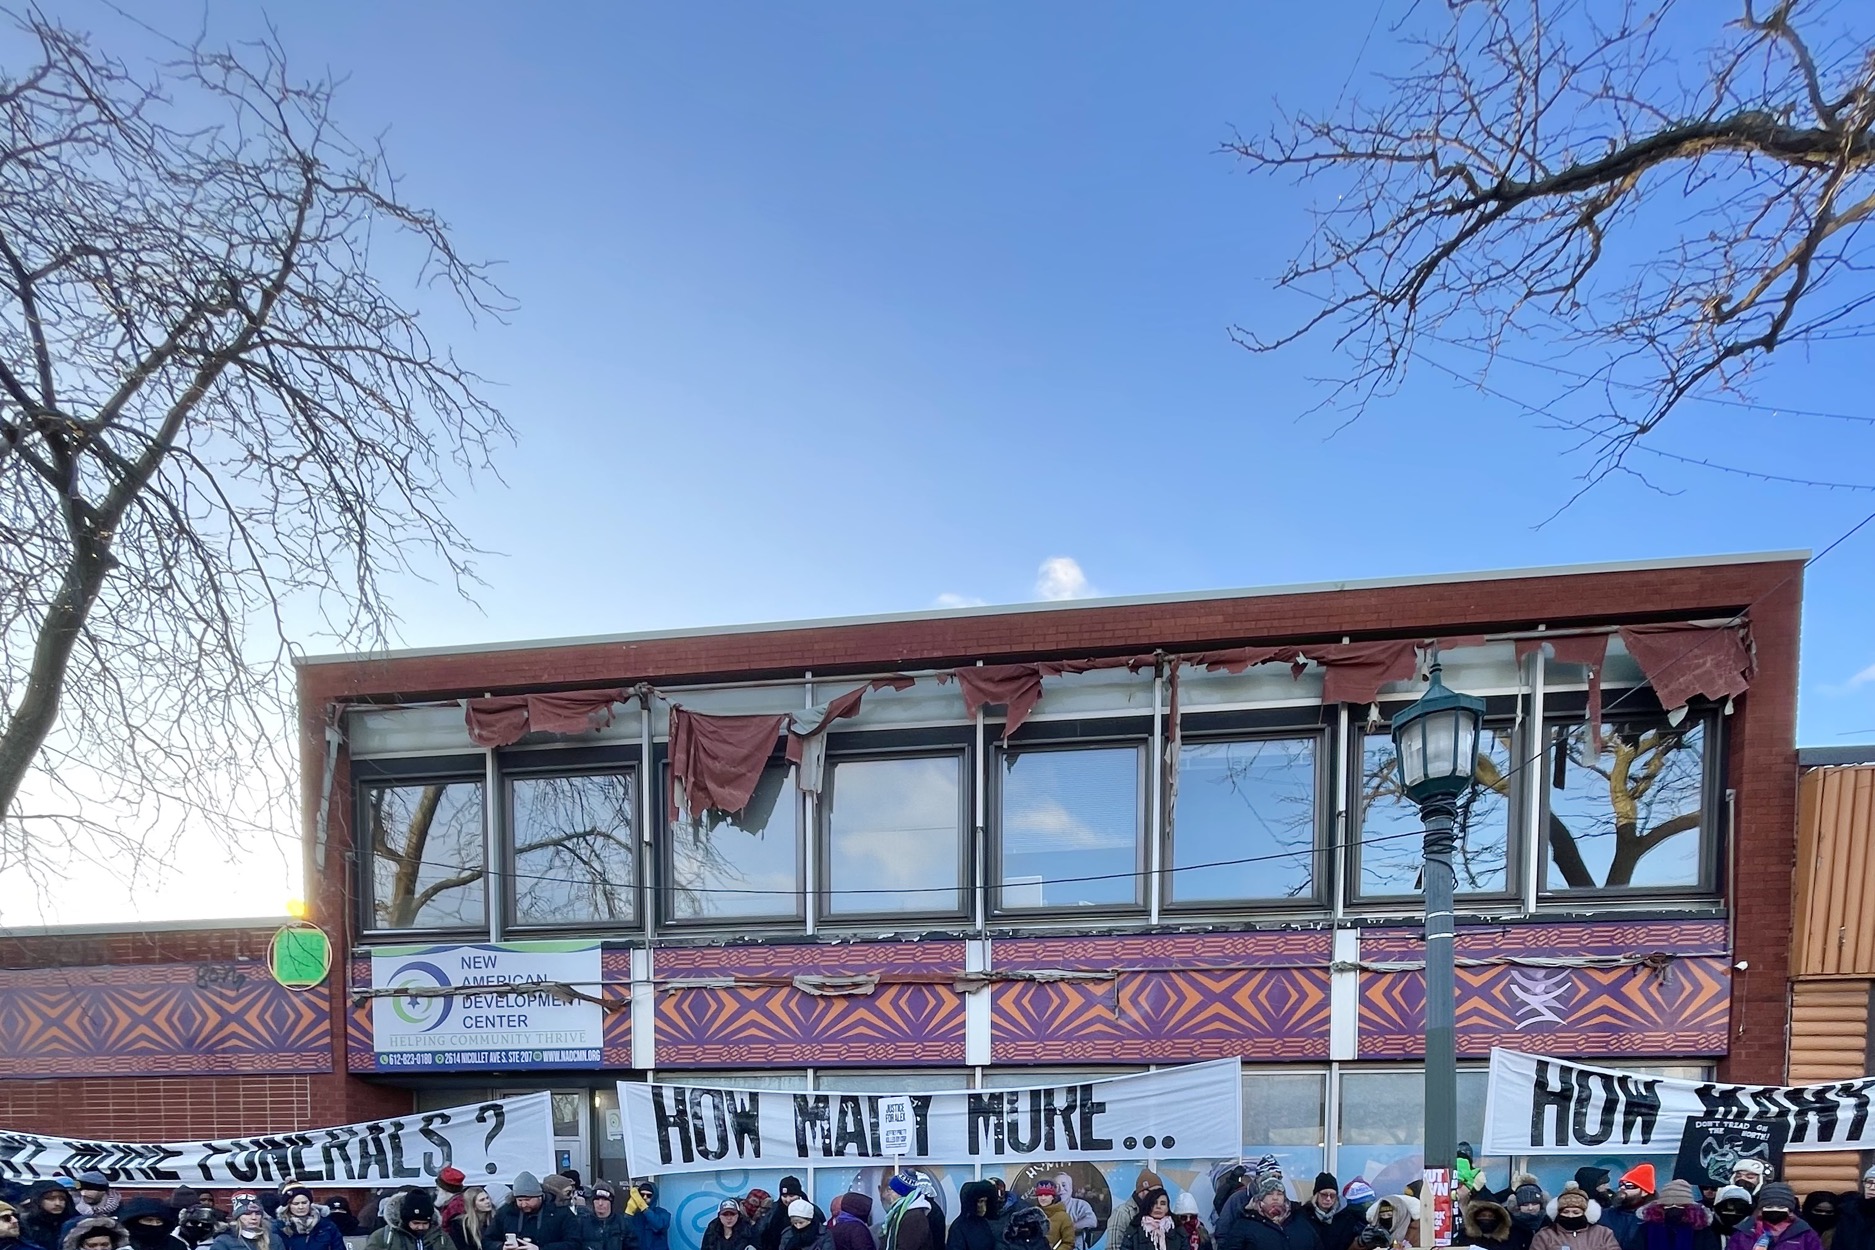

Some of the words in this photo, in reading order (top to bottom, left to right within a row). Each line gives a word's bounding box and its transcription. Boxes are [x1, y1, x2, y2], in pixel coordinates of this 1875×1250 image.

[461, 955, 497, 969] NEW
[463, 974, 548, 988] AMERICAN
[462, 1014, 528, 1029] CENTER
[390, 1035, 446, 1047] HELPING
[450, 1033, 532, 1046] COMMUNITY
[536, 1032, 587, 1044] THRIVE
[444, 1052, 461, 1065] 2614
[461, 1051, 489, 1064] NICOLLET
[489, 1051, 501, 1063] AVE
[508, 1051, 520, 1063] STE
[520, 1050, 533, 1062] 207
[886, 1103, 905, 1114] JUSTICE
[1529, 1059, 1664, 1148] HOW
[652, 1084, 762, 1165] HOW
[1695, 1120, 1720, 1129] DON'T
[1723, 1120, 1750, 1130] TREAD
[1756, 1124, 1768, 1133] ON
[1708, 1127, 1724, 1135] THE
[1741, 1130, 1770, 1142] NORTH!
